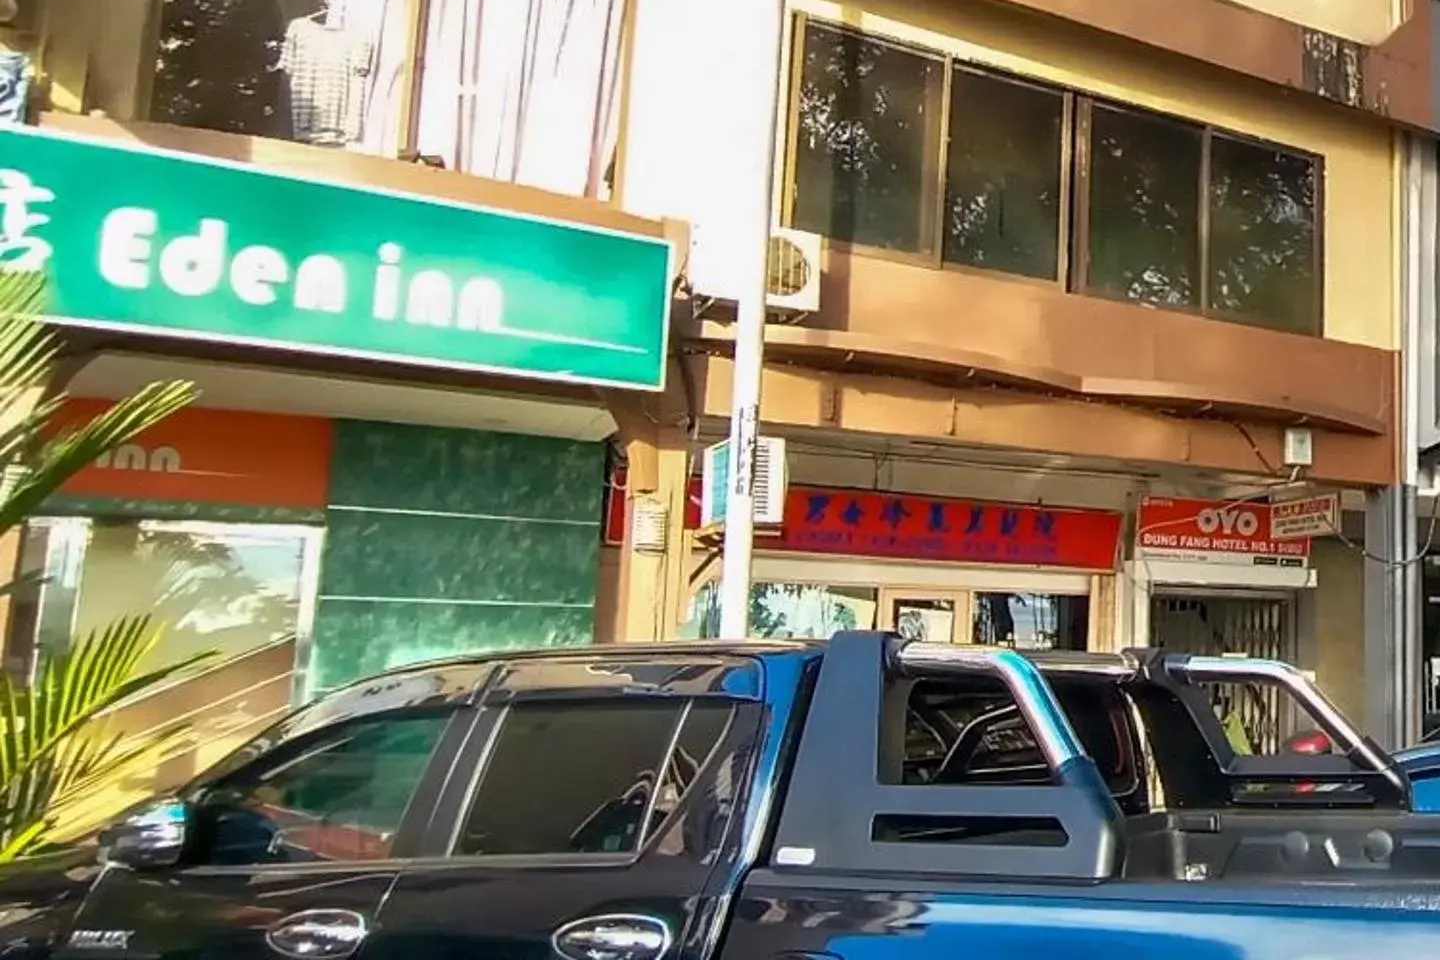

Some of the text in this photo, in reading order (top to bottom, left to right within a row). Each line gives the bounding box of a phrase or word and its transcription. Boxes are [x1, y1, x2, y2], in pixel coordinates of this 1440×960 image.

[99, 206, 504, 333] Eden inn
[1198, 507, 1258, 536] OYO
[1143, 534, 1177, 547] DUNG
[1180, 535, 1210, 549] FANG
[1213, 537, 1249, 551] HOTEL
